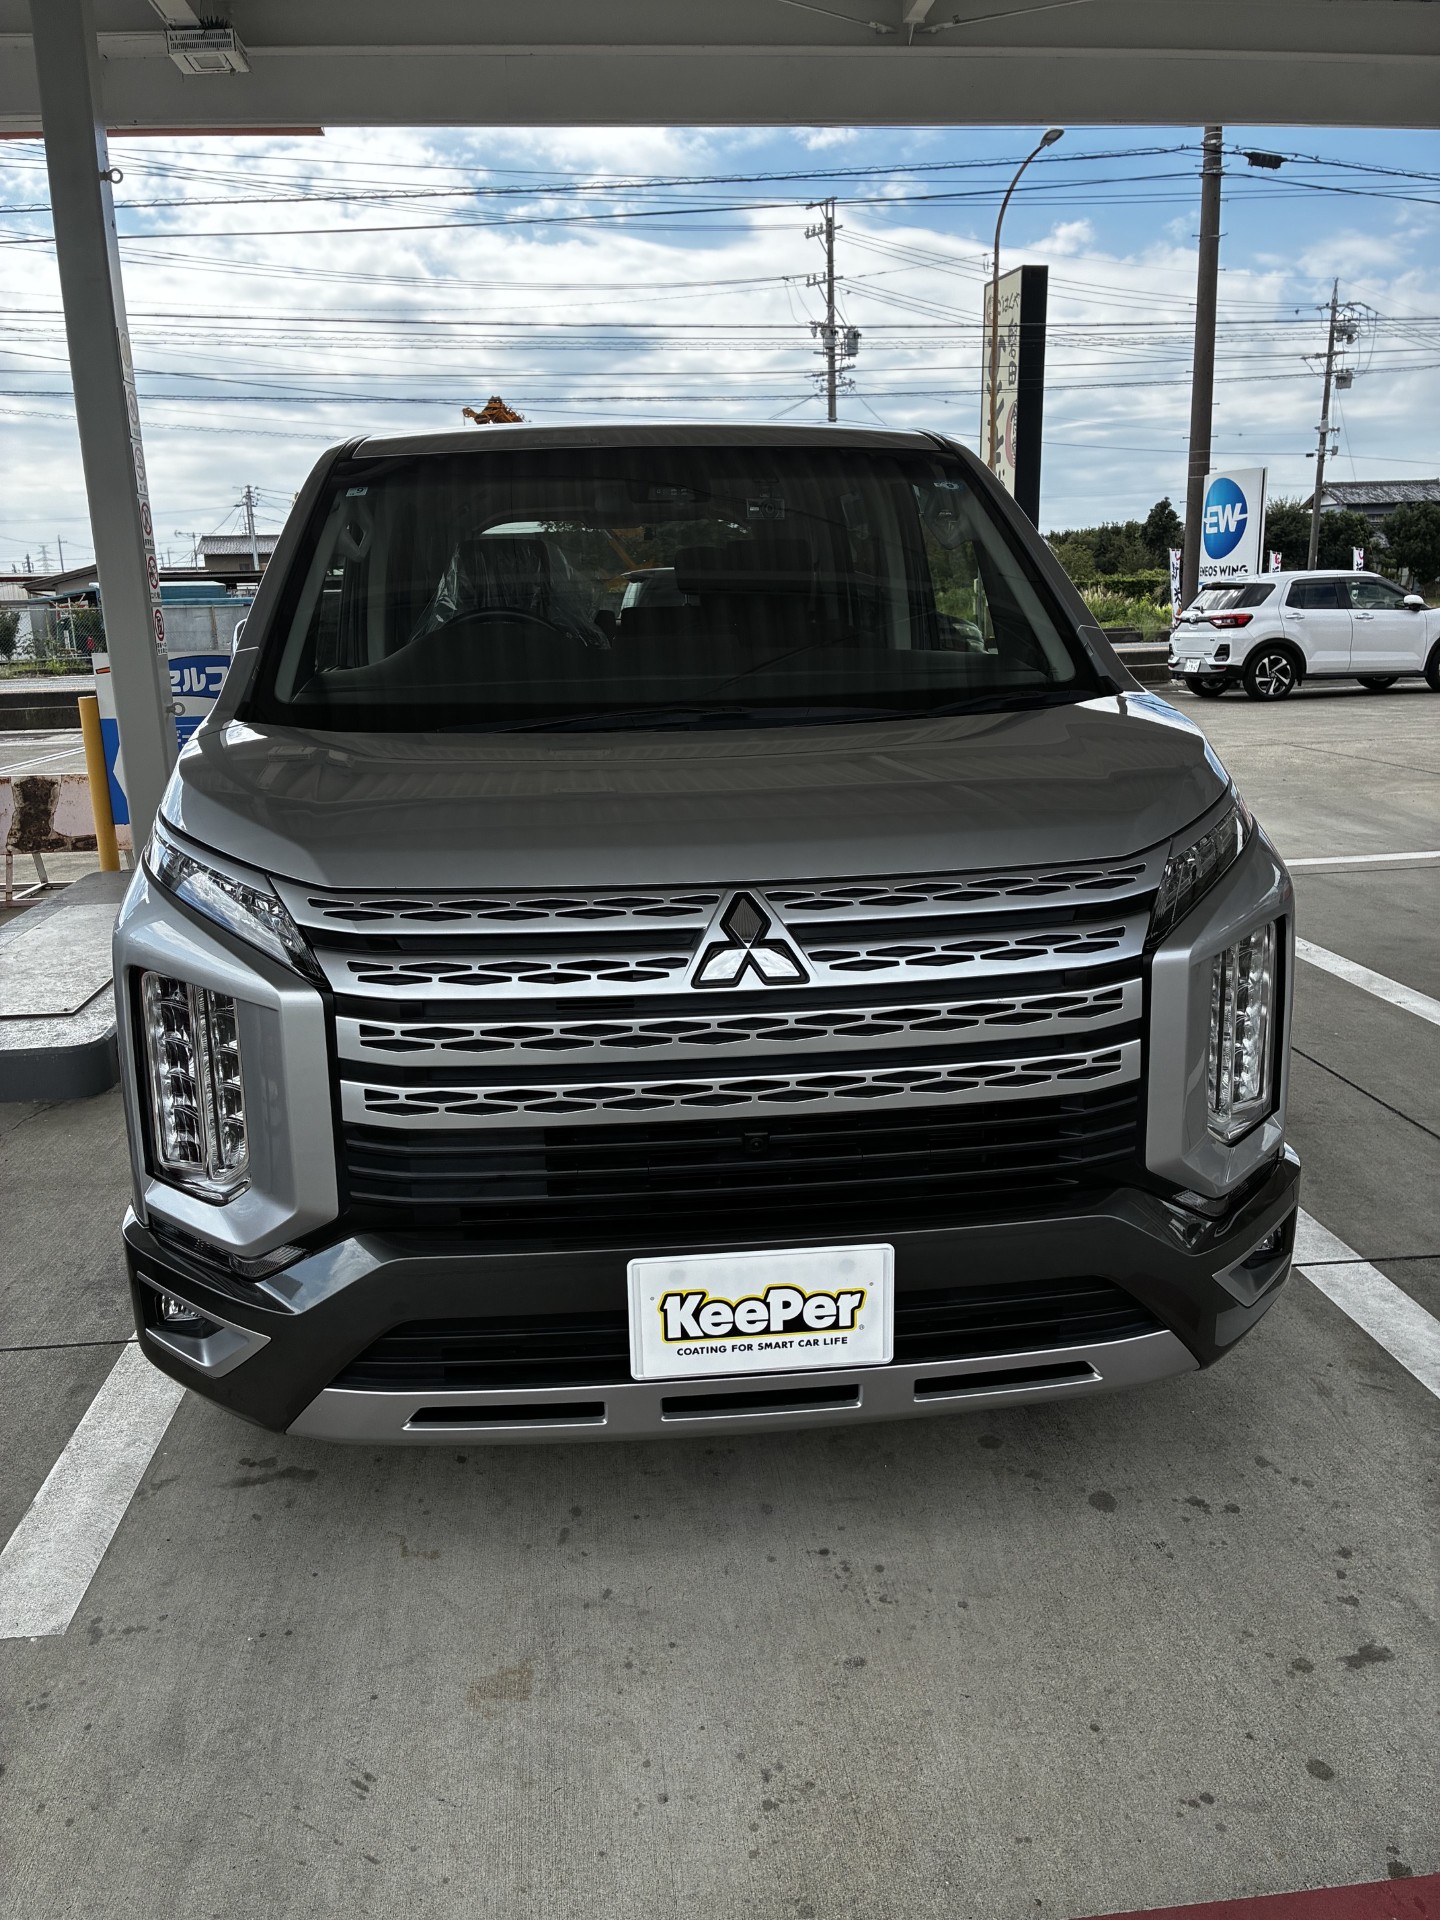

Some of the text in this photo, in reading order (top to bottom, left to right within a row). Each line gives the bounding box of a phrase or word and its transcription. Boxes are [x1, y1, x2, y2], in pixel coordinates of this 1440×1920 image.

[1205, 502, 1243, 534] EW
[1199, 564, 1249, 577] ENEOS WING
[660, 1285, 865, 1342] KeePer
[676, 1336, 848, 1357] COATING FOR SMART CAR LIFE
